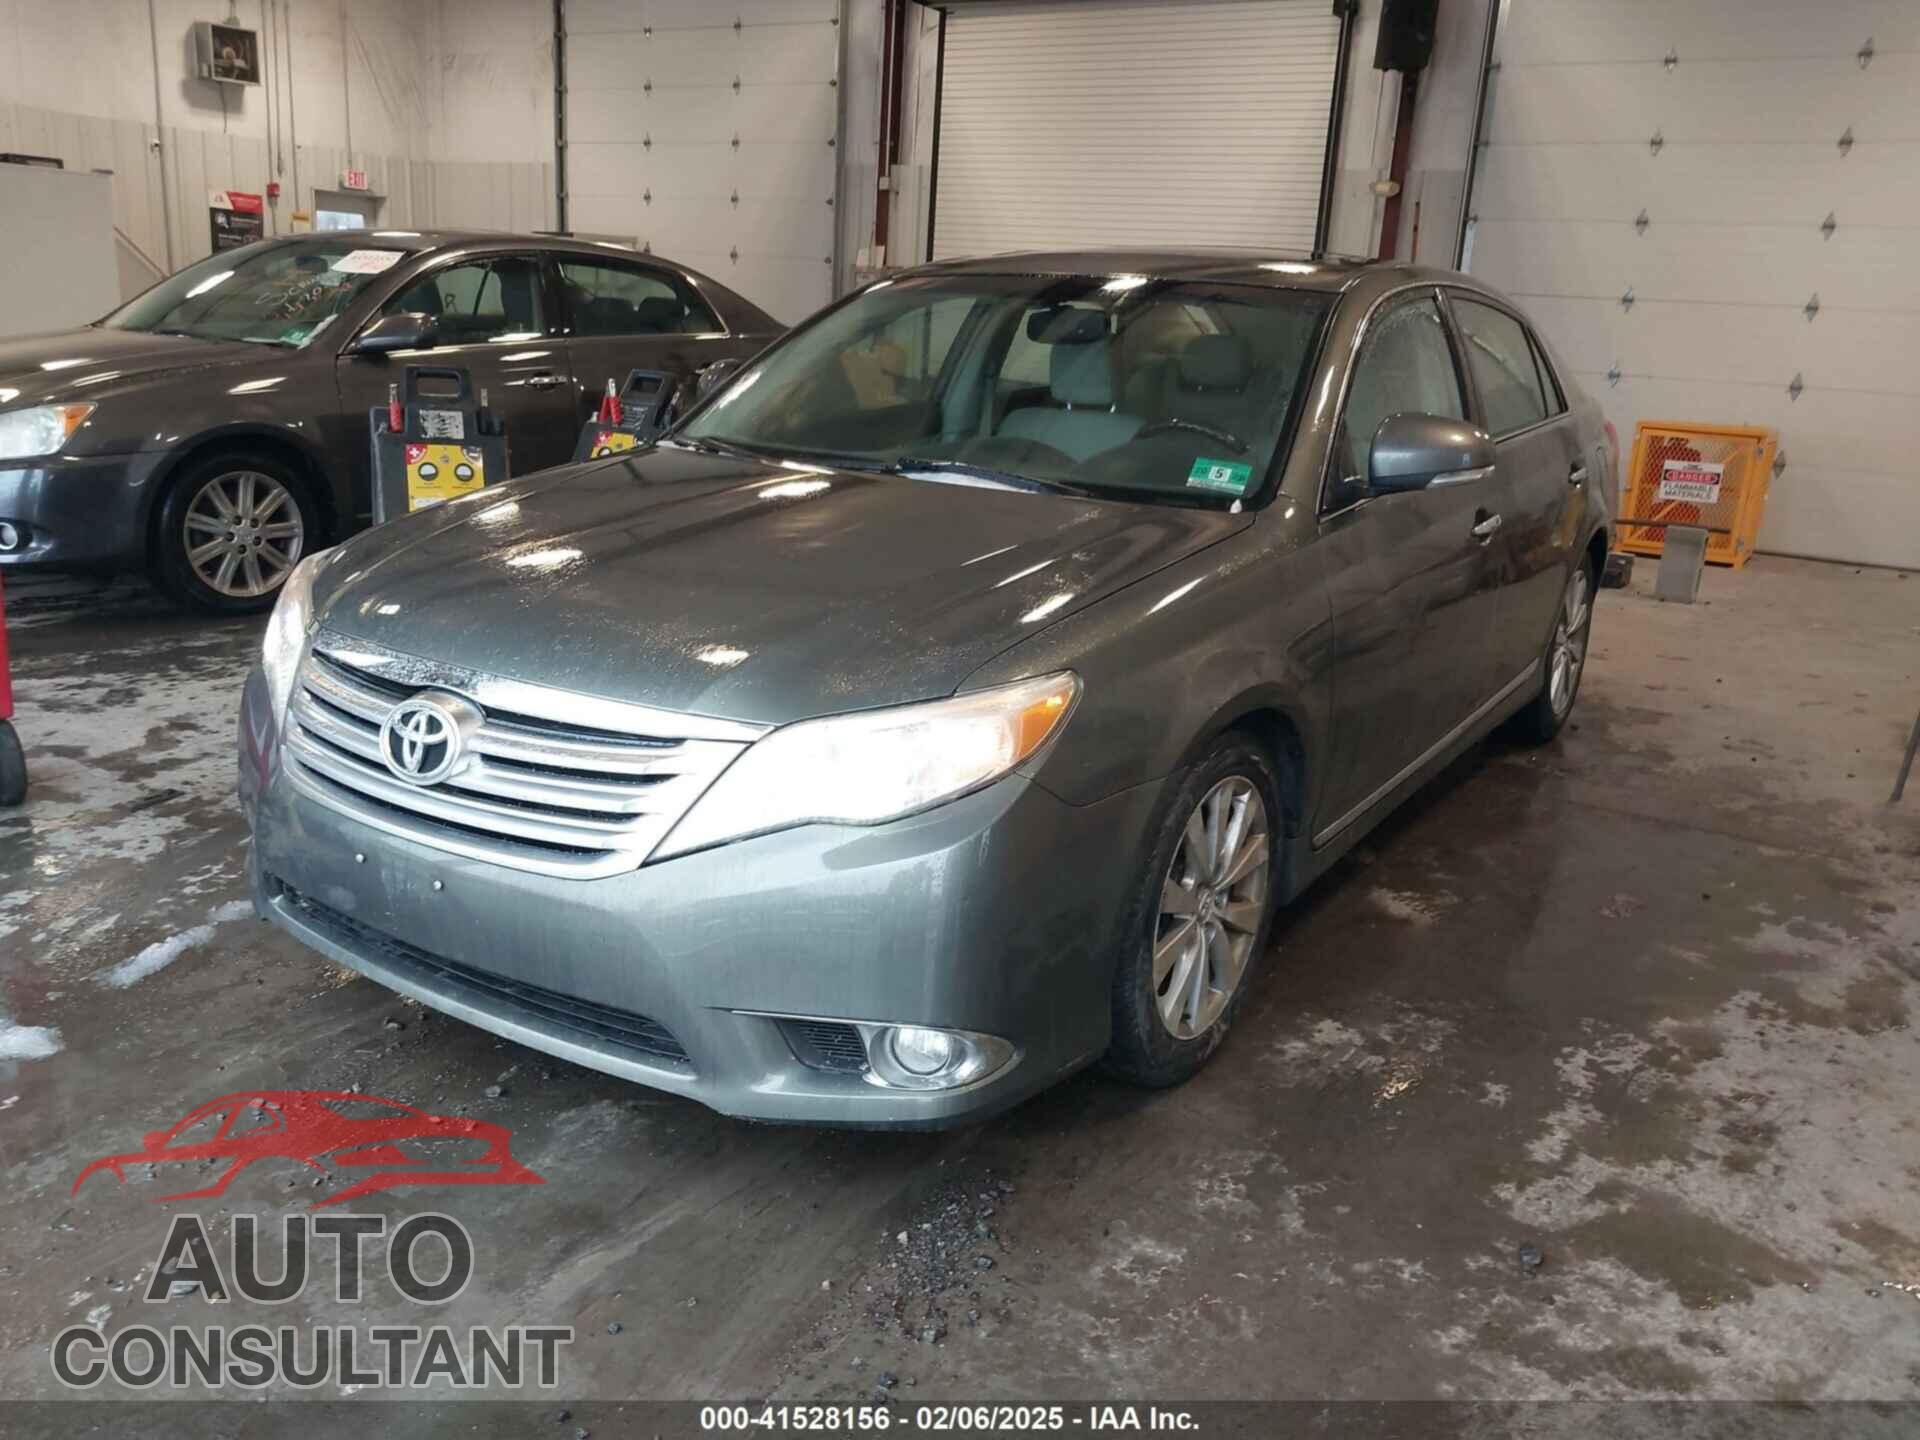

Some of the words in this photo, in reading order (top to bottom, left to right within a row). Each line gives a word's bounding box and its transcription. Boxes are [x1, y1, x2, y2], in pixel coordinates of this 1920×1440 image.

[348, 171, 366, 188] EXIT
[1214, 467, 1225, 479] 5
[1671, 471, 1713, 484] DANGER
[1664, 482, 1713, 493] FLAMMABLE
